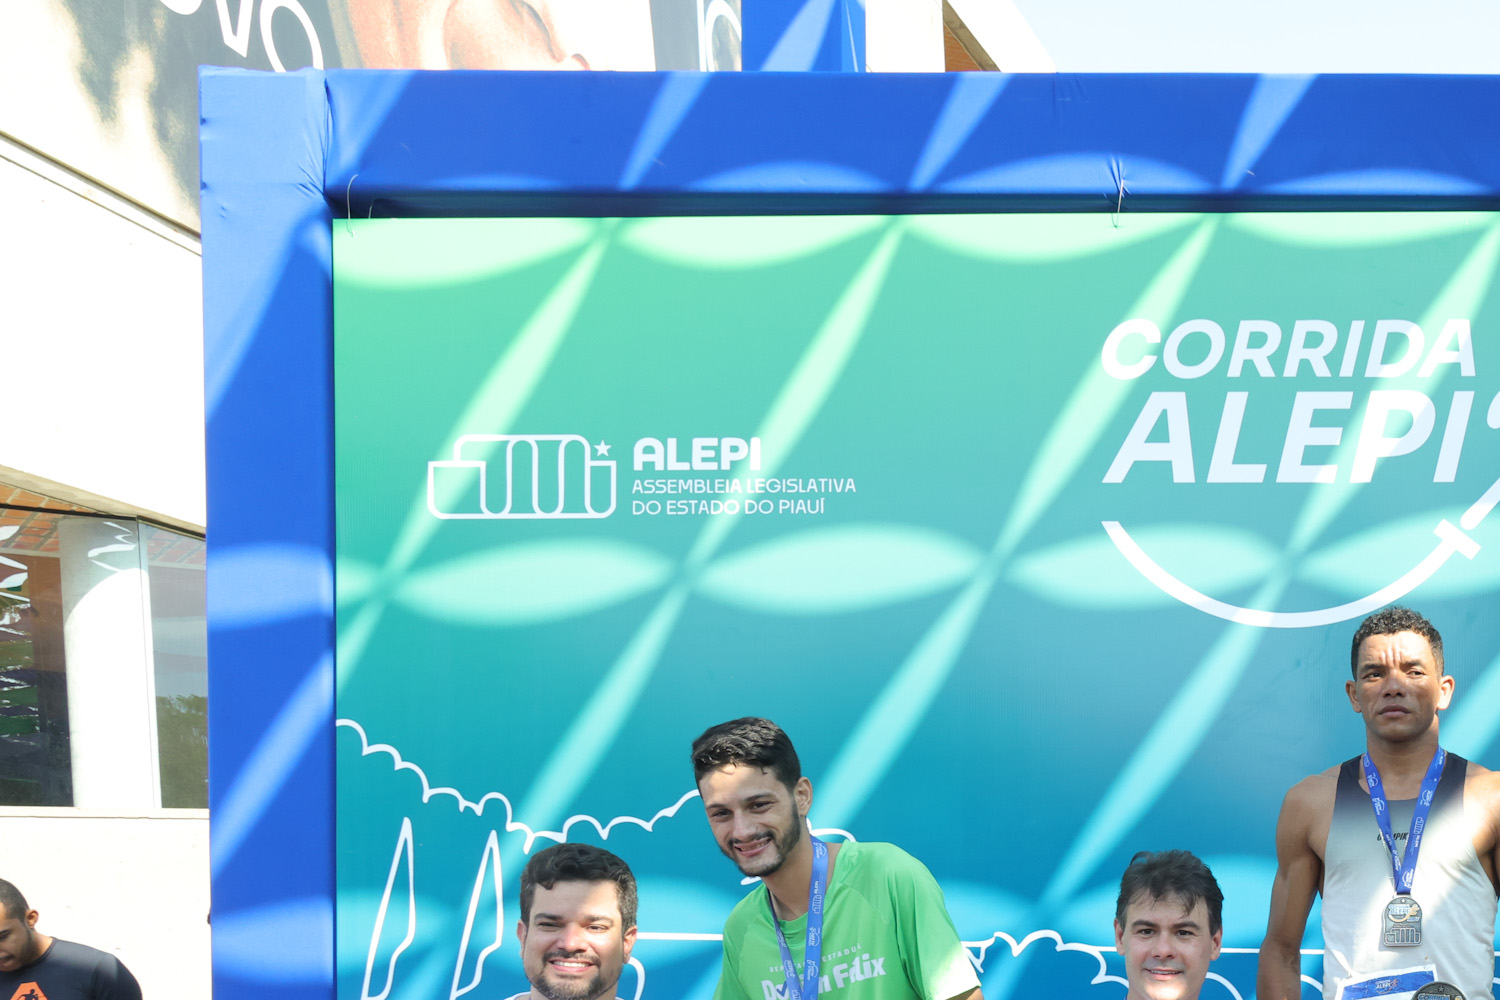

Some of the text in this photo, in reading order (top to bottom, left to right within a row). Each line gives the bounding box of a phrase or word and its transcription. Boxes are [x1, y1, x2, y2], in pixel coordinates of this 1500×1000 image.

[1101, 318, 1476, 380] CORRIDA
[1102, 390, 1475, 483] ALEPI
[632, 437, 761, 471] ALEPI
[632, 478, 856, 494] ASSEMBLEIA LEGISLATIVA
[632, 497, 826, 515] DO ESTADO DO PIAUÍ
